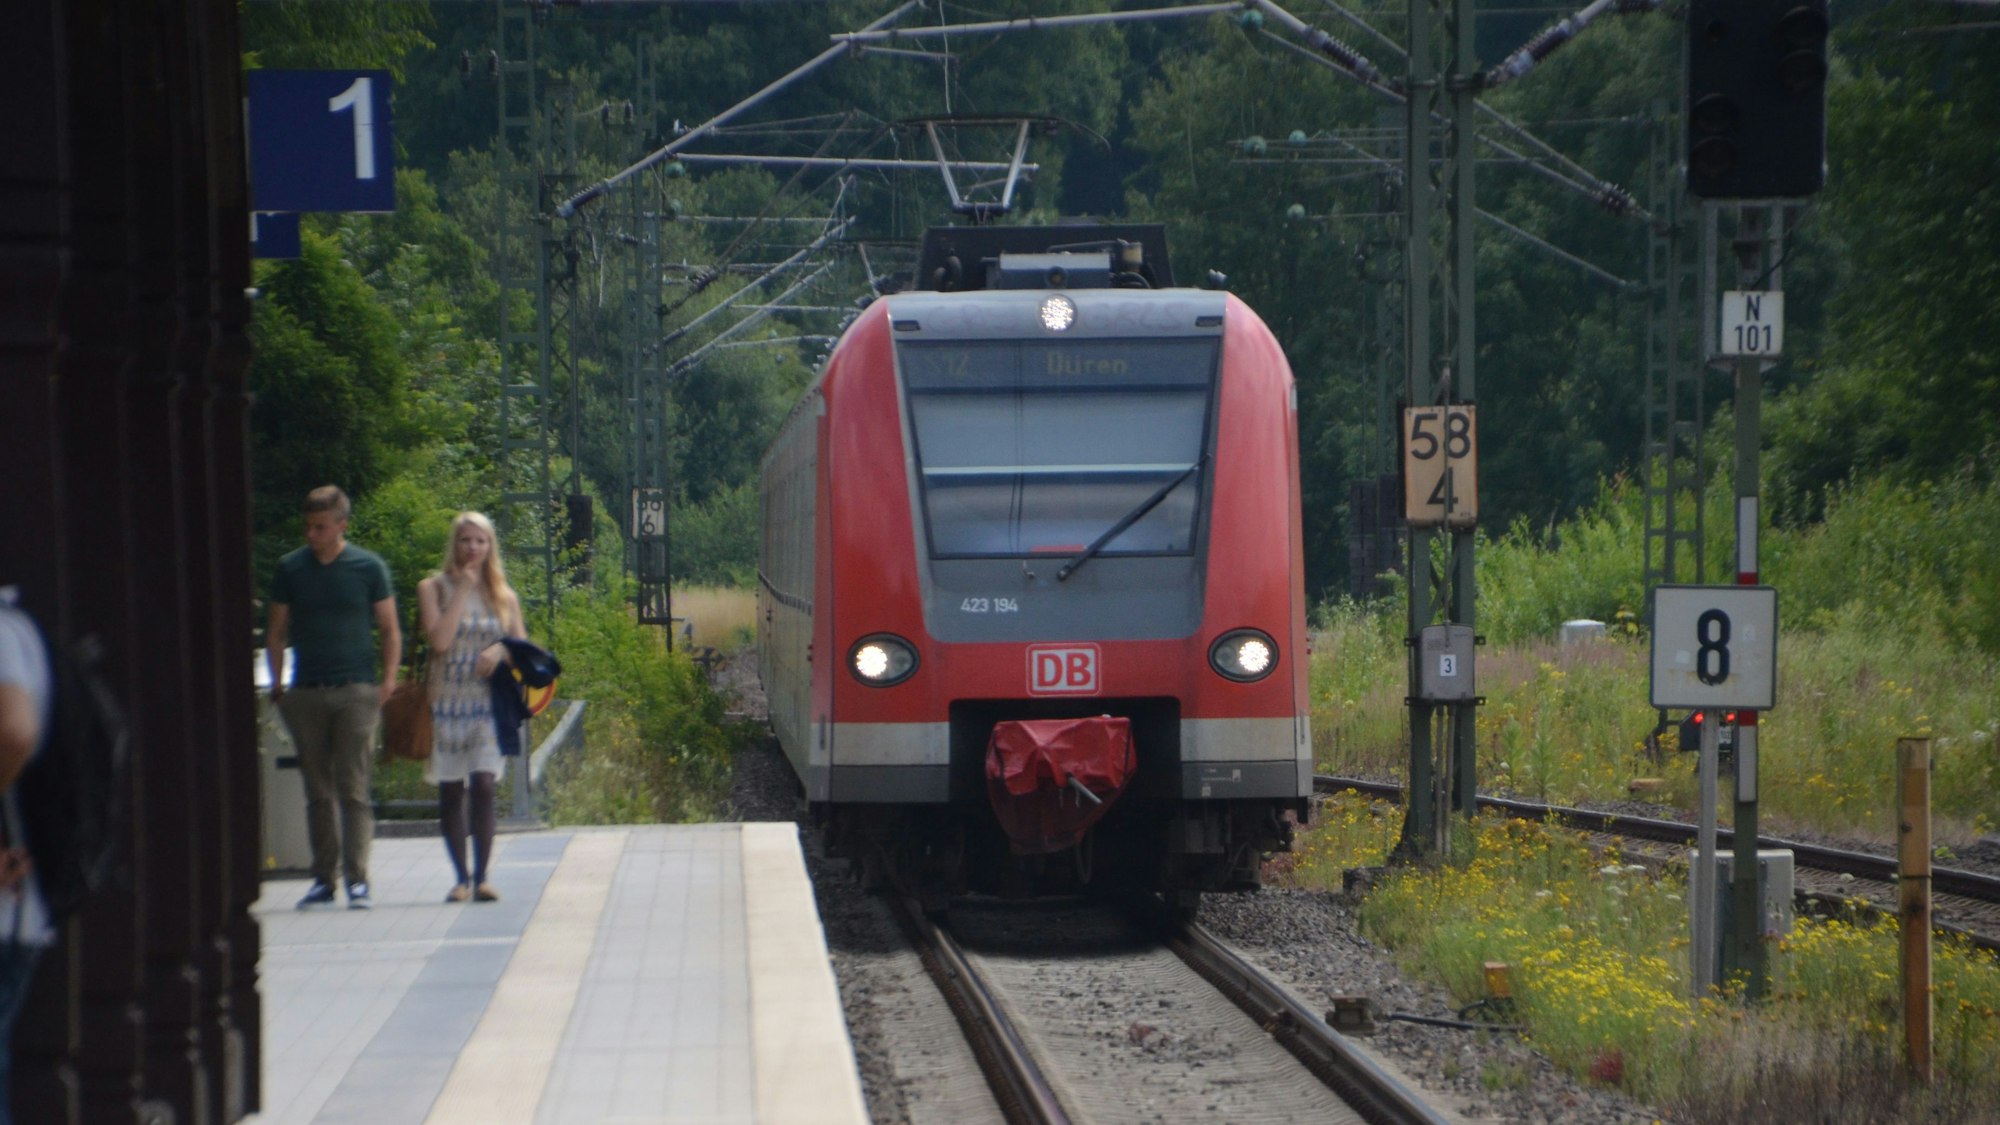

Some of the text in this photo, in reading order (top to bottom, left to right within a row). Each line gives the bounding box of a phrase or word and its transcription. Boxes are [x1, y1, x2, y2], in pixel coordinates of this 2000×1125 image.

[328, 77, 375, 179] 1
[1746, 295, 1760, 321] N
[1735, 325, 1771, 351] 101
[1047, 352, 1128, 375] Düren
[1411, 412, 1471, 460] 58
[1426, 466, 1458, 513] 4
[961, 598, 1018, 612] 423 194
[1697, 608, 1731, 686] 8
[1037, 652, 1092, 687] DB
[1444, 657, 1452, 673] 3
